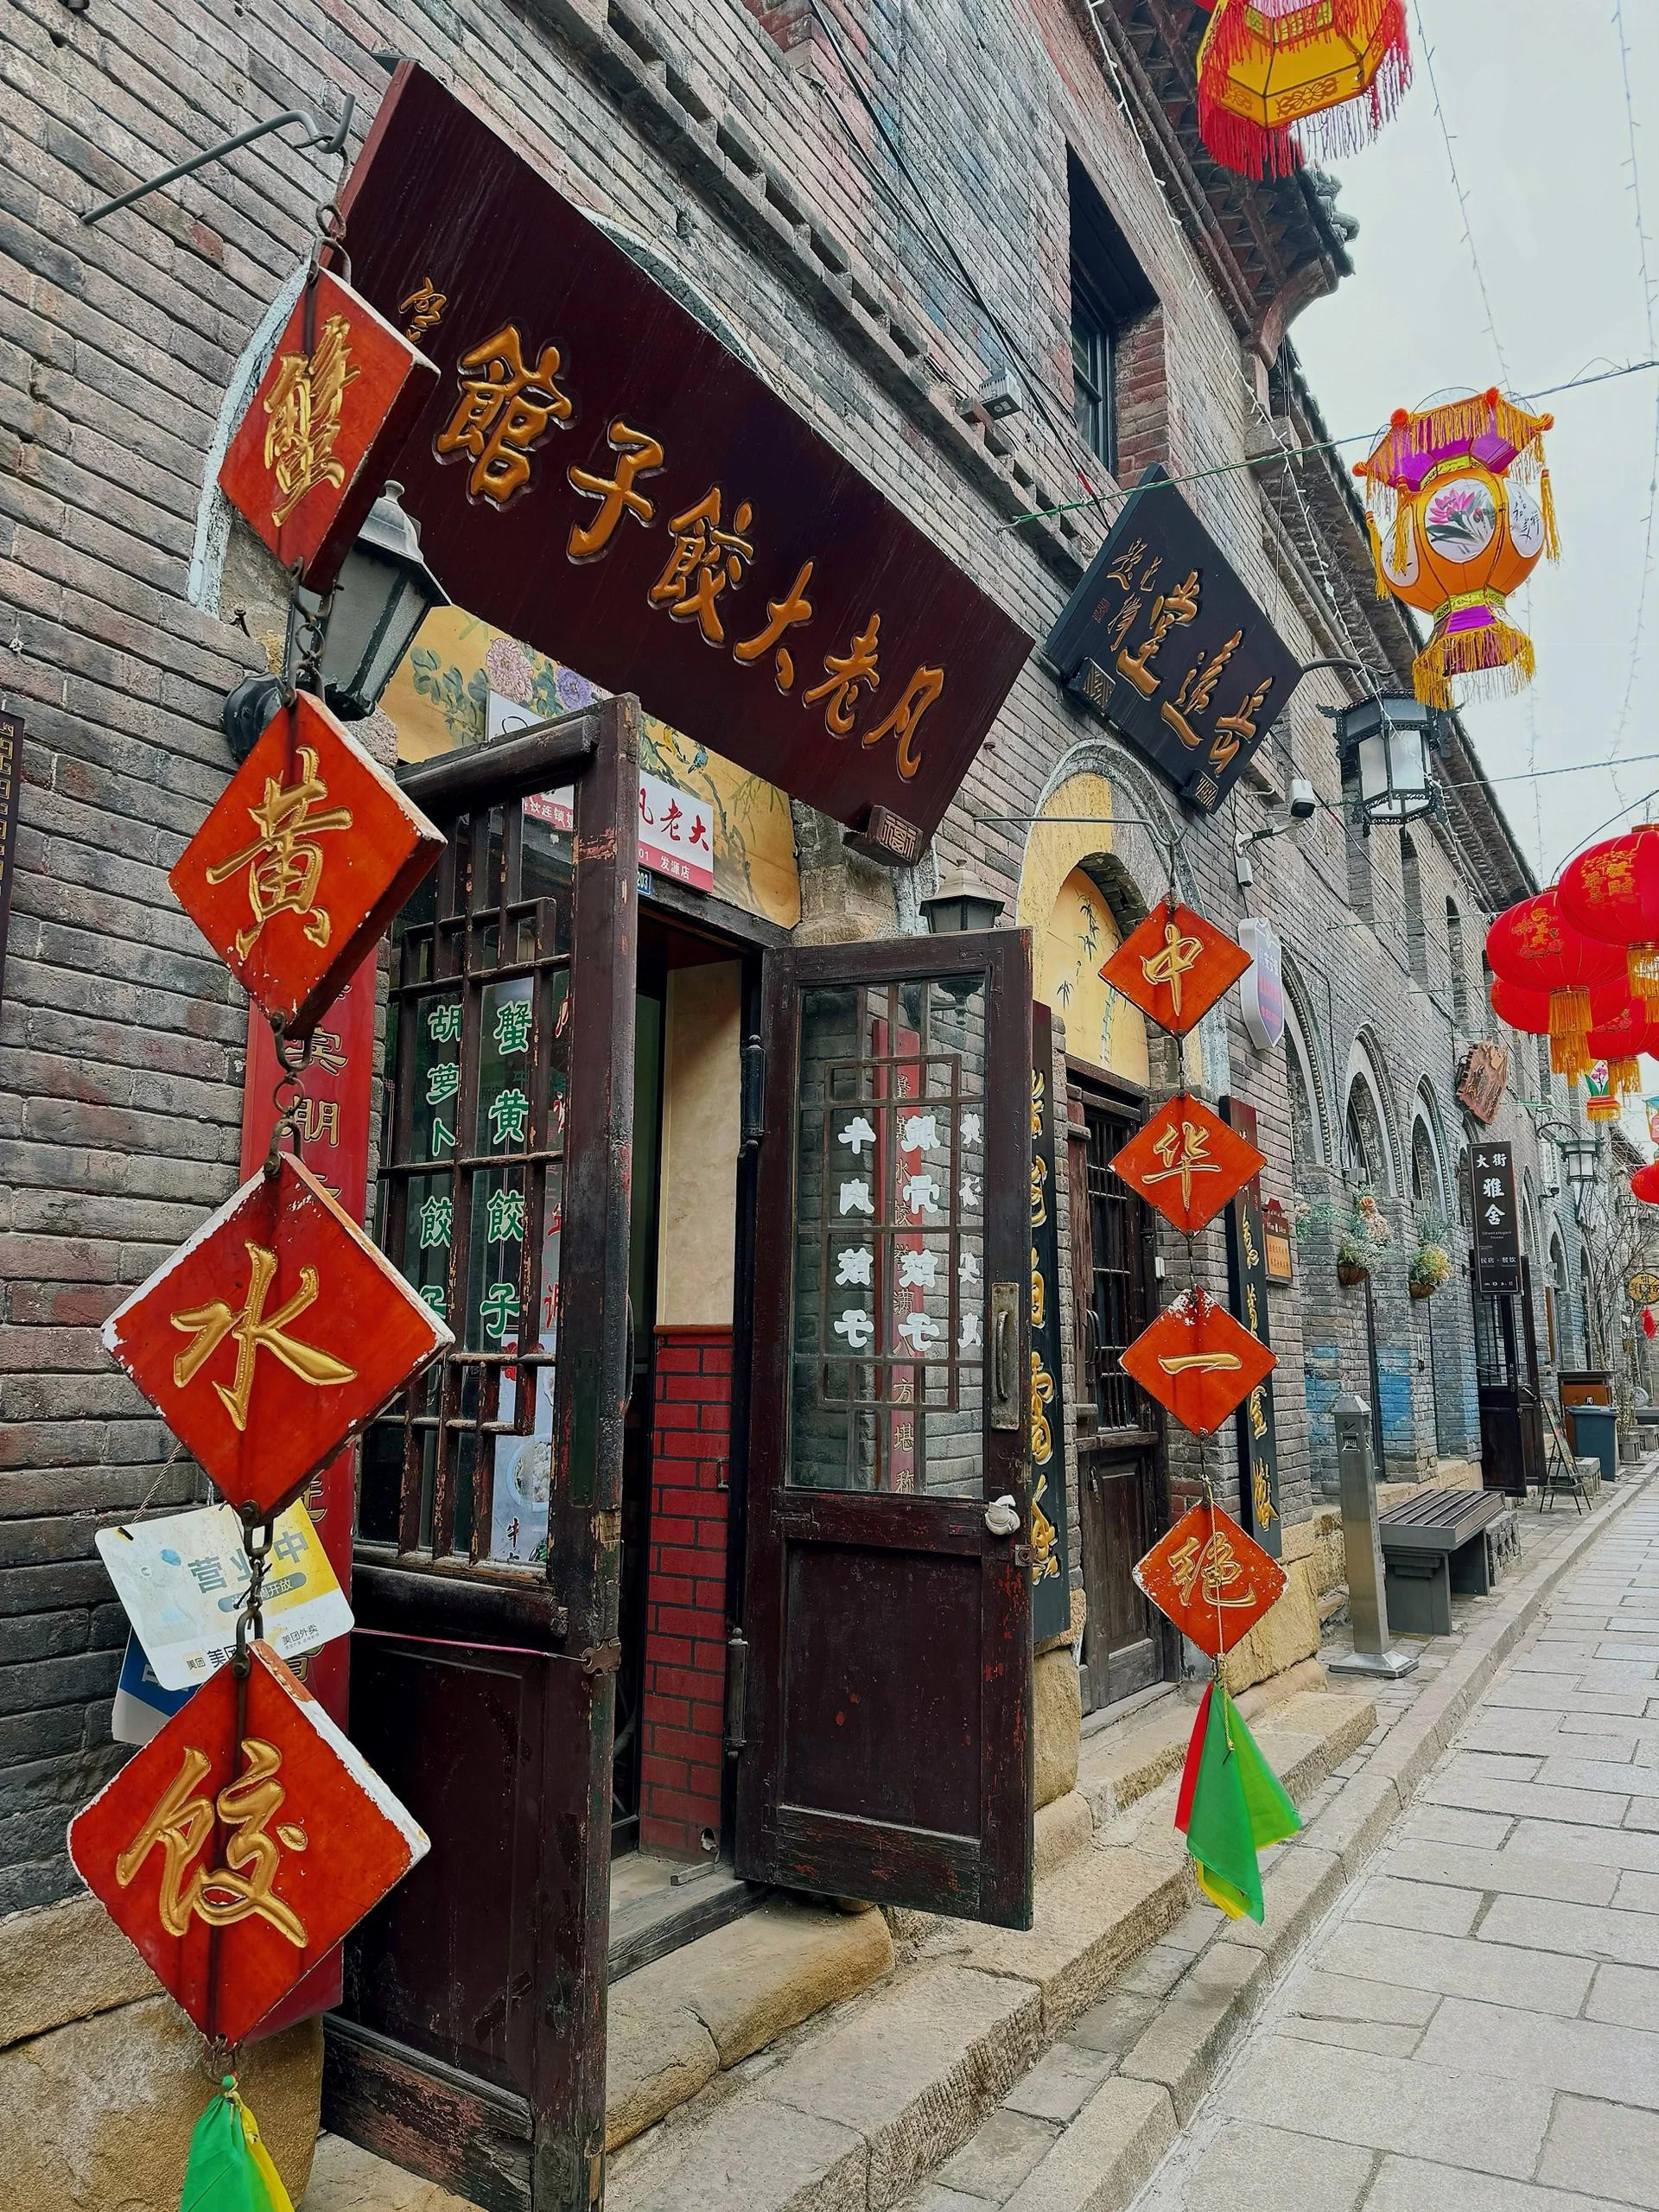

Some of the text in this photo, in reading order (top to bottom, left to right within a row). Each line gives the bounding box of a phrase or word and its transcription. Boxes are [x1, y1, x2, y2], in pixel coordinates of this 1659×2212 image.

[660, 855, 690, 880] 发源店
[1476, 1153, 1507, 1168] 大街
[1483, 1178, 1505, 1225] 雅舍
[283, 1624, 319, 1646] 美团外卖
